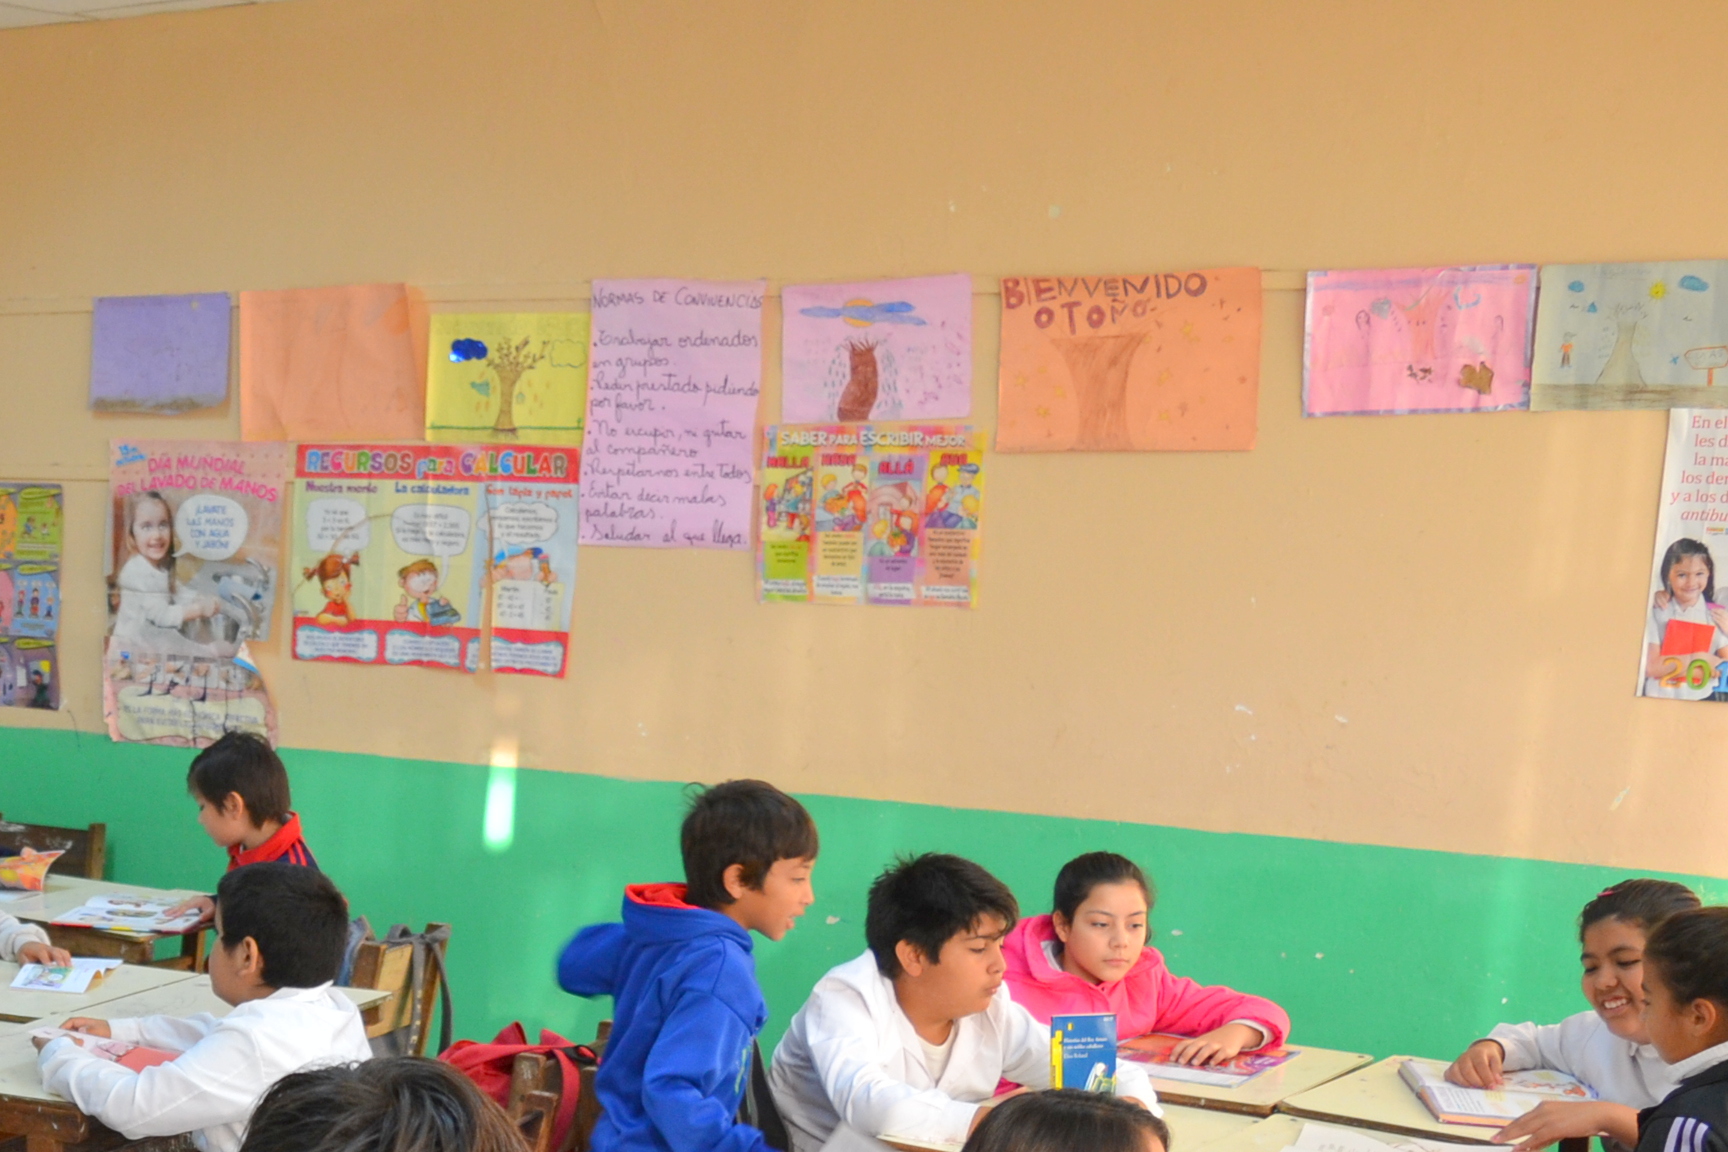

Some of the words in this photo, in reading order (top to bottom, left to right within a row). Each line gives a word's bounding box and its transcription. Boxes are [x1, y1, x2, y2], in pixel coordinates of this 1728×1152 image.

[653, 290, 666, 303] DE
[1003, 273, 1207, 309] BIENVENIDO
[1692, 415, 1710, 429] En
[781, 431, 829, 447] SABER
[829, 434, 857, 446] PARA
[860, 431, 924, 447] ESCRIBIR
[925, 434, 966, 447] MEJOR
[1695, 434, 1715, 447] les
[177, 455, 246, 474] MUNDIAL
[305, 449, 412, 474] RECURSOS
[415, 456, 456, 479] para
[460, 450, 568, 478] CALCULAR
[1694, 453, 1706, 466] la
[1681, 471, 1702, 484] los
[141, 474, 197, 492] LAVADO
[201, 477, 217, 489] DE
[219, 477, 278, 502] MANOS
[1670, 492, 1680, 505] y
[1683, 492, 1691, 502] a
[1695, 489, 1716, 503] los
